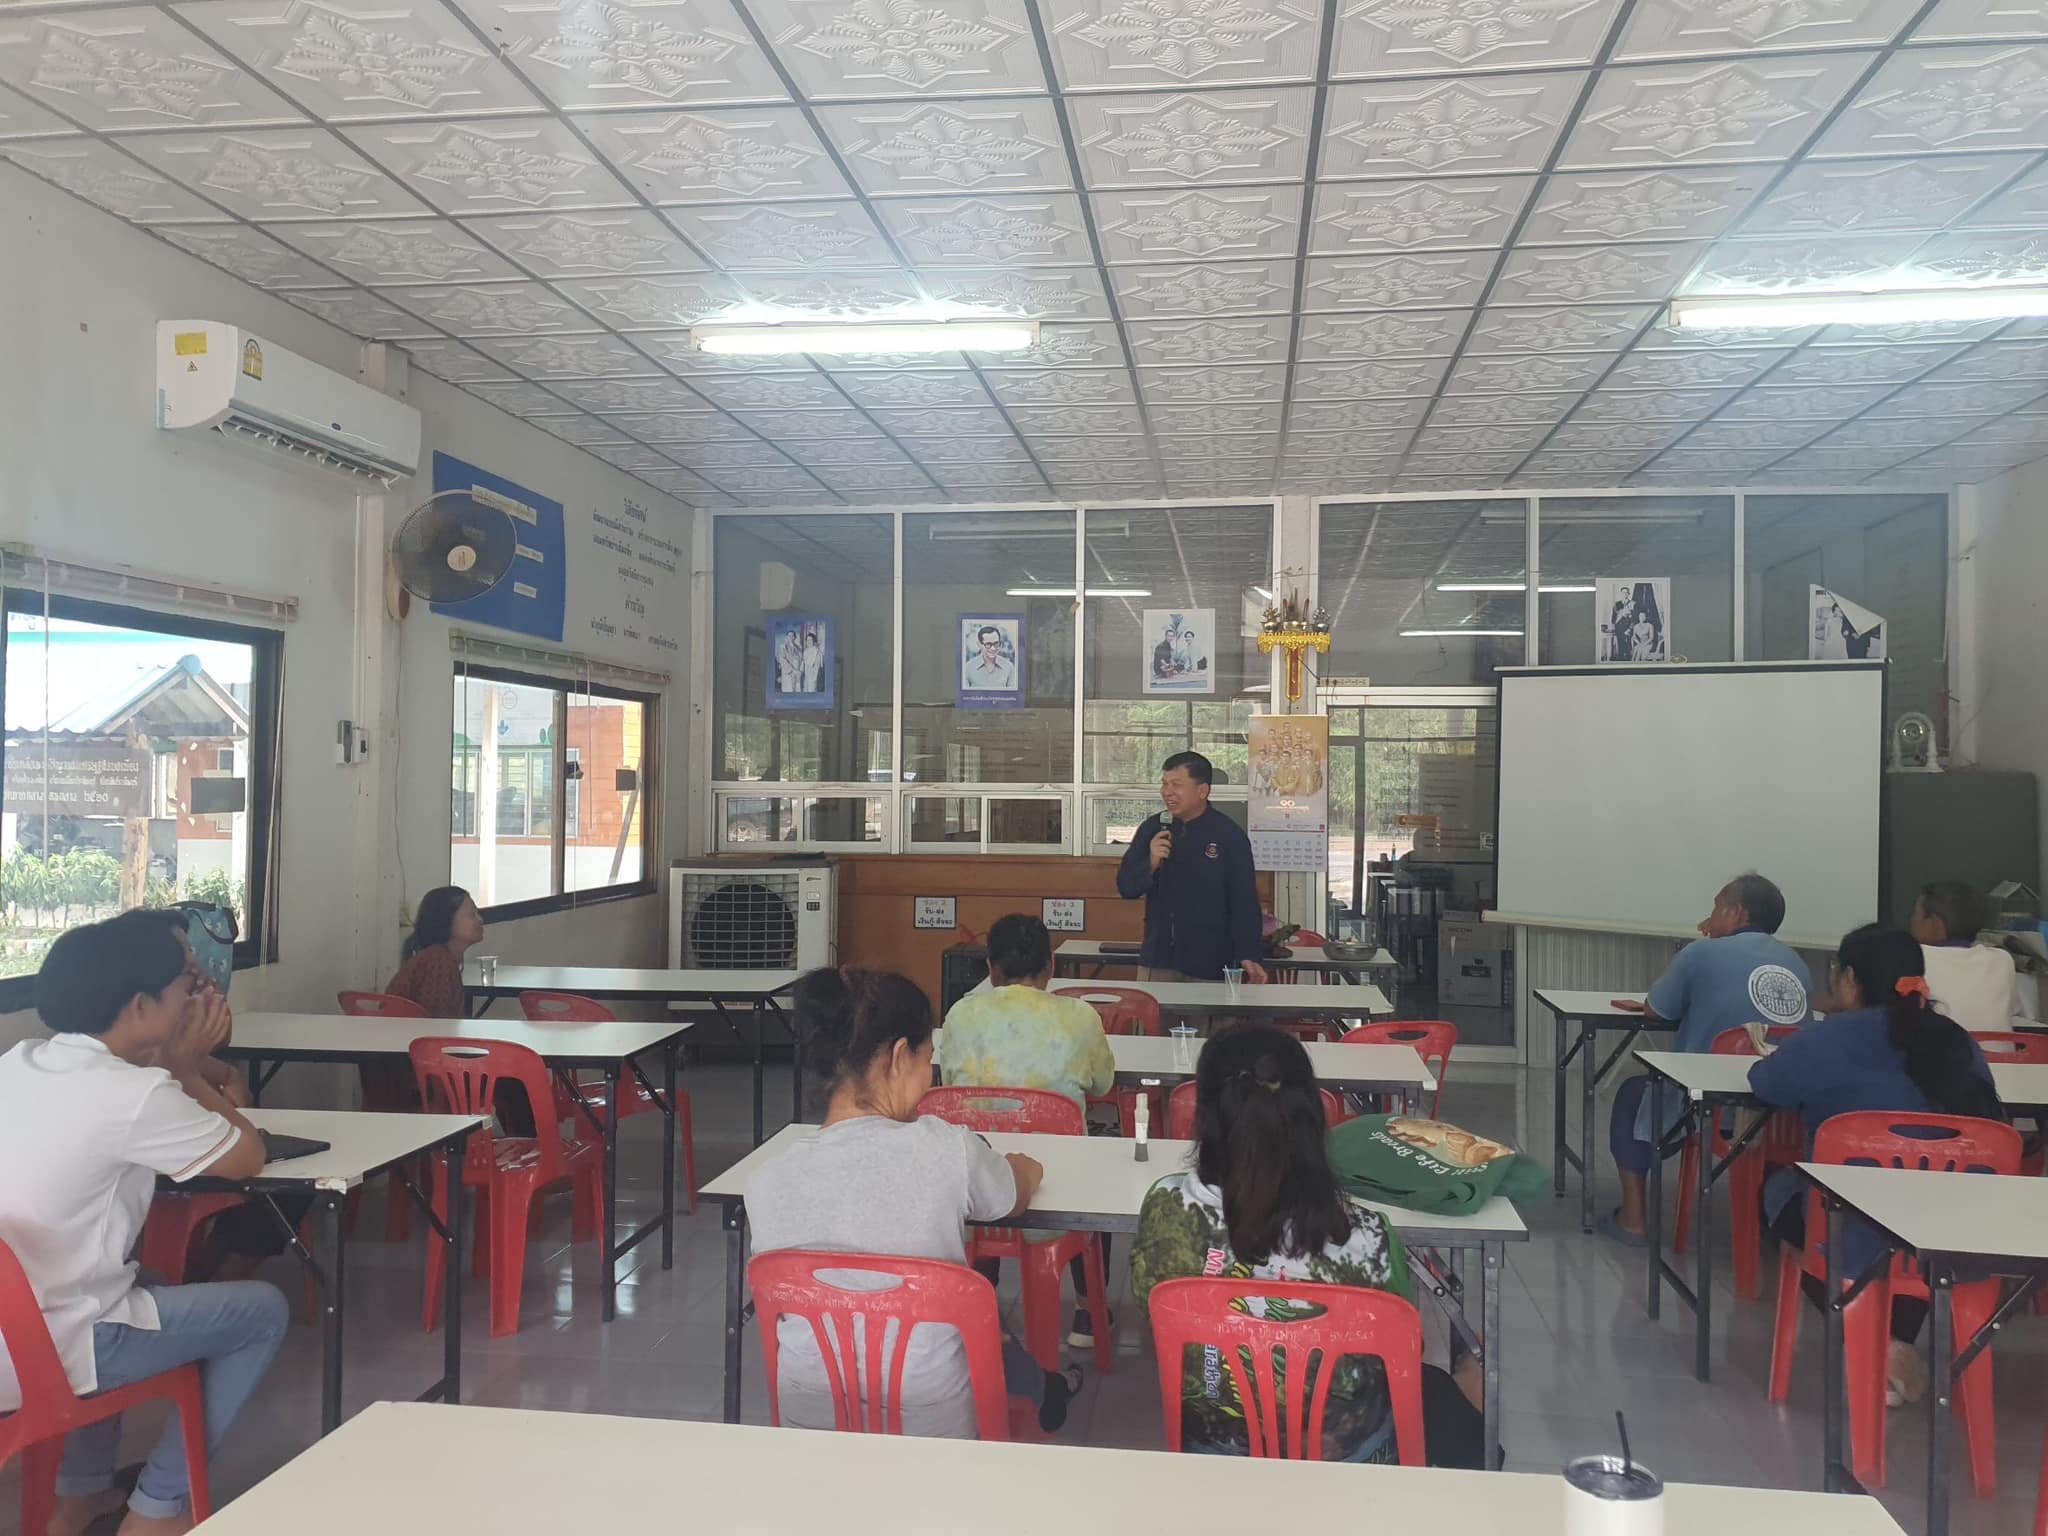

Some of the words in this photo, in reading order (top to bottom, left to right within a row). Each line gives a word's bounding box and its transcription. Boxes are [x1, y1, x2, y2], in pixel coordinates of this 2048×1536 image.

[1368, 1131, 1414, 1157] Breads
[1415, 1154, 1450, 1175] Life
[1205, 1343, 1222, 1398] arathon
